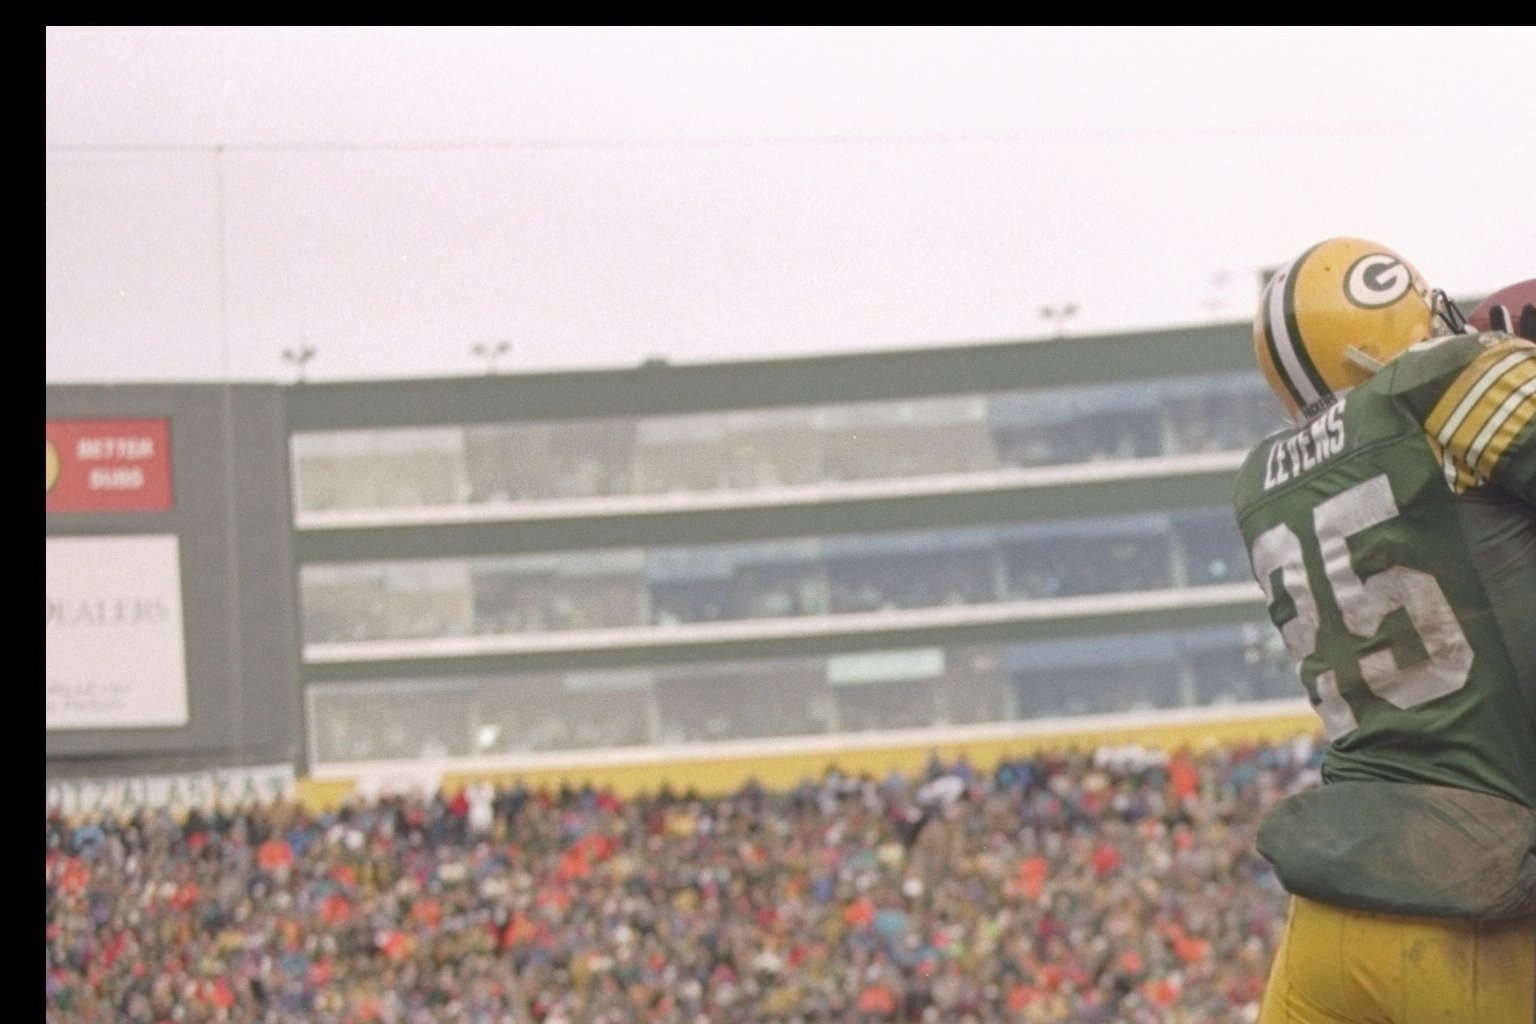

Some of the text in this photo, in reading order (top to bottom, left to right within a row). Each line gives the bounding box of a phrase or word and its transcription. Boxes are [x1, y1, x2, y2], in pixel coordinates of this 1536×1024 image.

[1347, 253, 1411, 306] G
[1263, 400, 1346, 490] LEVENS
[1252, 473, 1475, 742] 25
